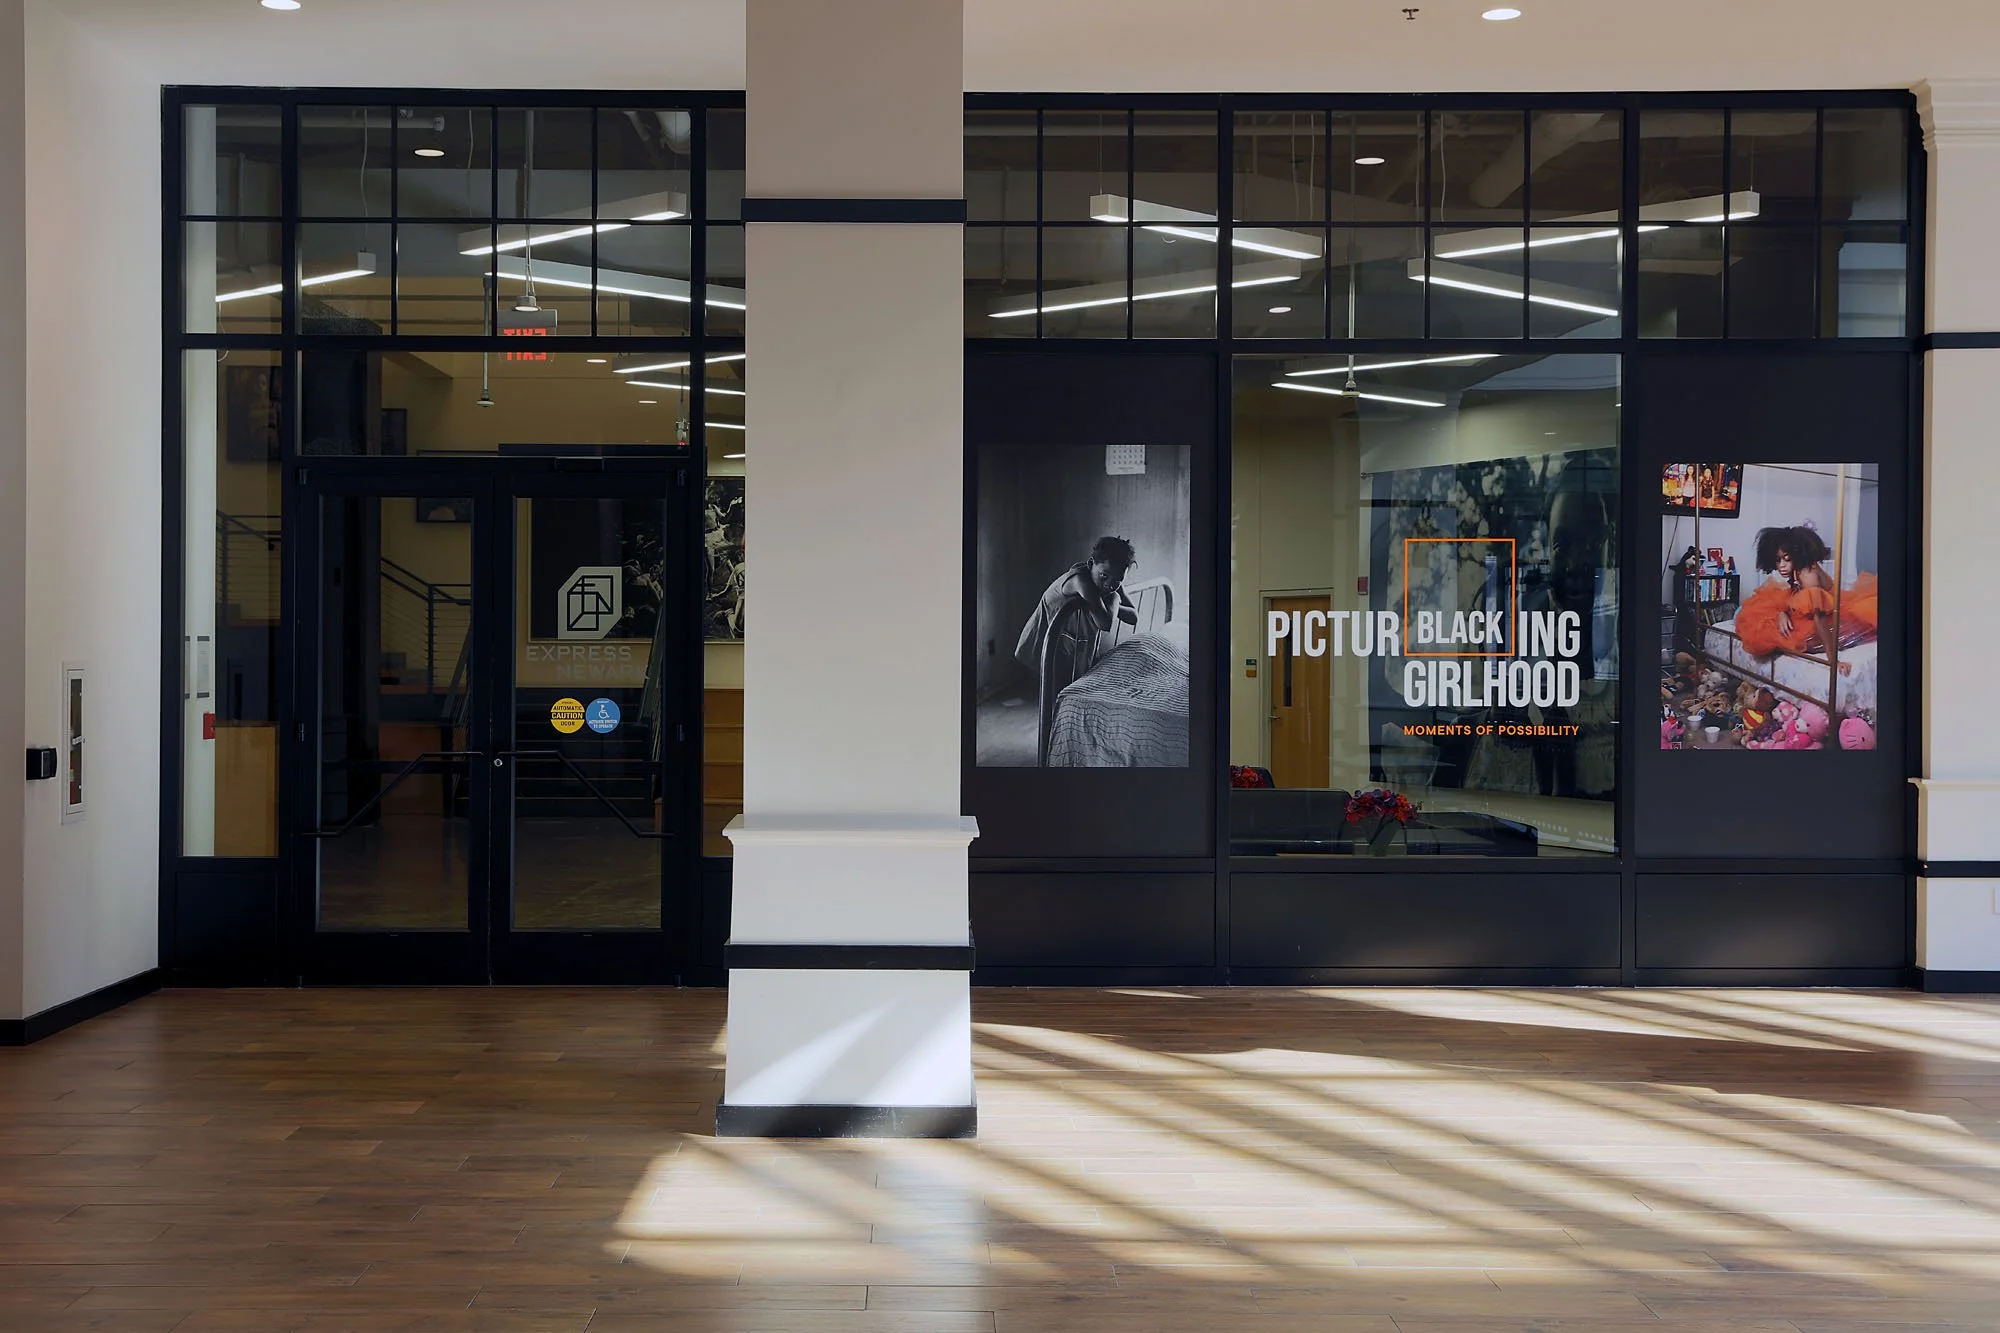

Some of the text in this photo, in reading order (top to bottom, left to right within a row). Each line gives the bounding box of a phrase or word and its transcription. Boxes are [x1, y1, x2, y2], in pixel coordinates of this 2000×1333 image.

[1267, 610, 1581, 658] PICTUR BLACK ING
[525, 645, 632, 662] EXPRESS
[1403, 660, 1580, 708] GIRLHOOD
[1403, 725, 1580, 737] MOMENTS OF POSSIBILITY
